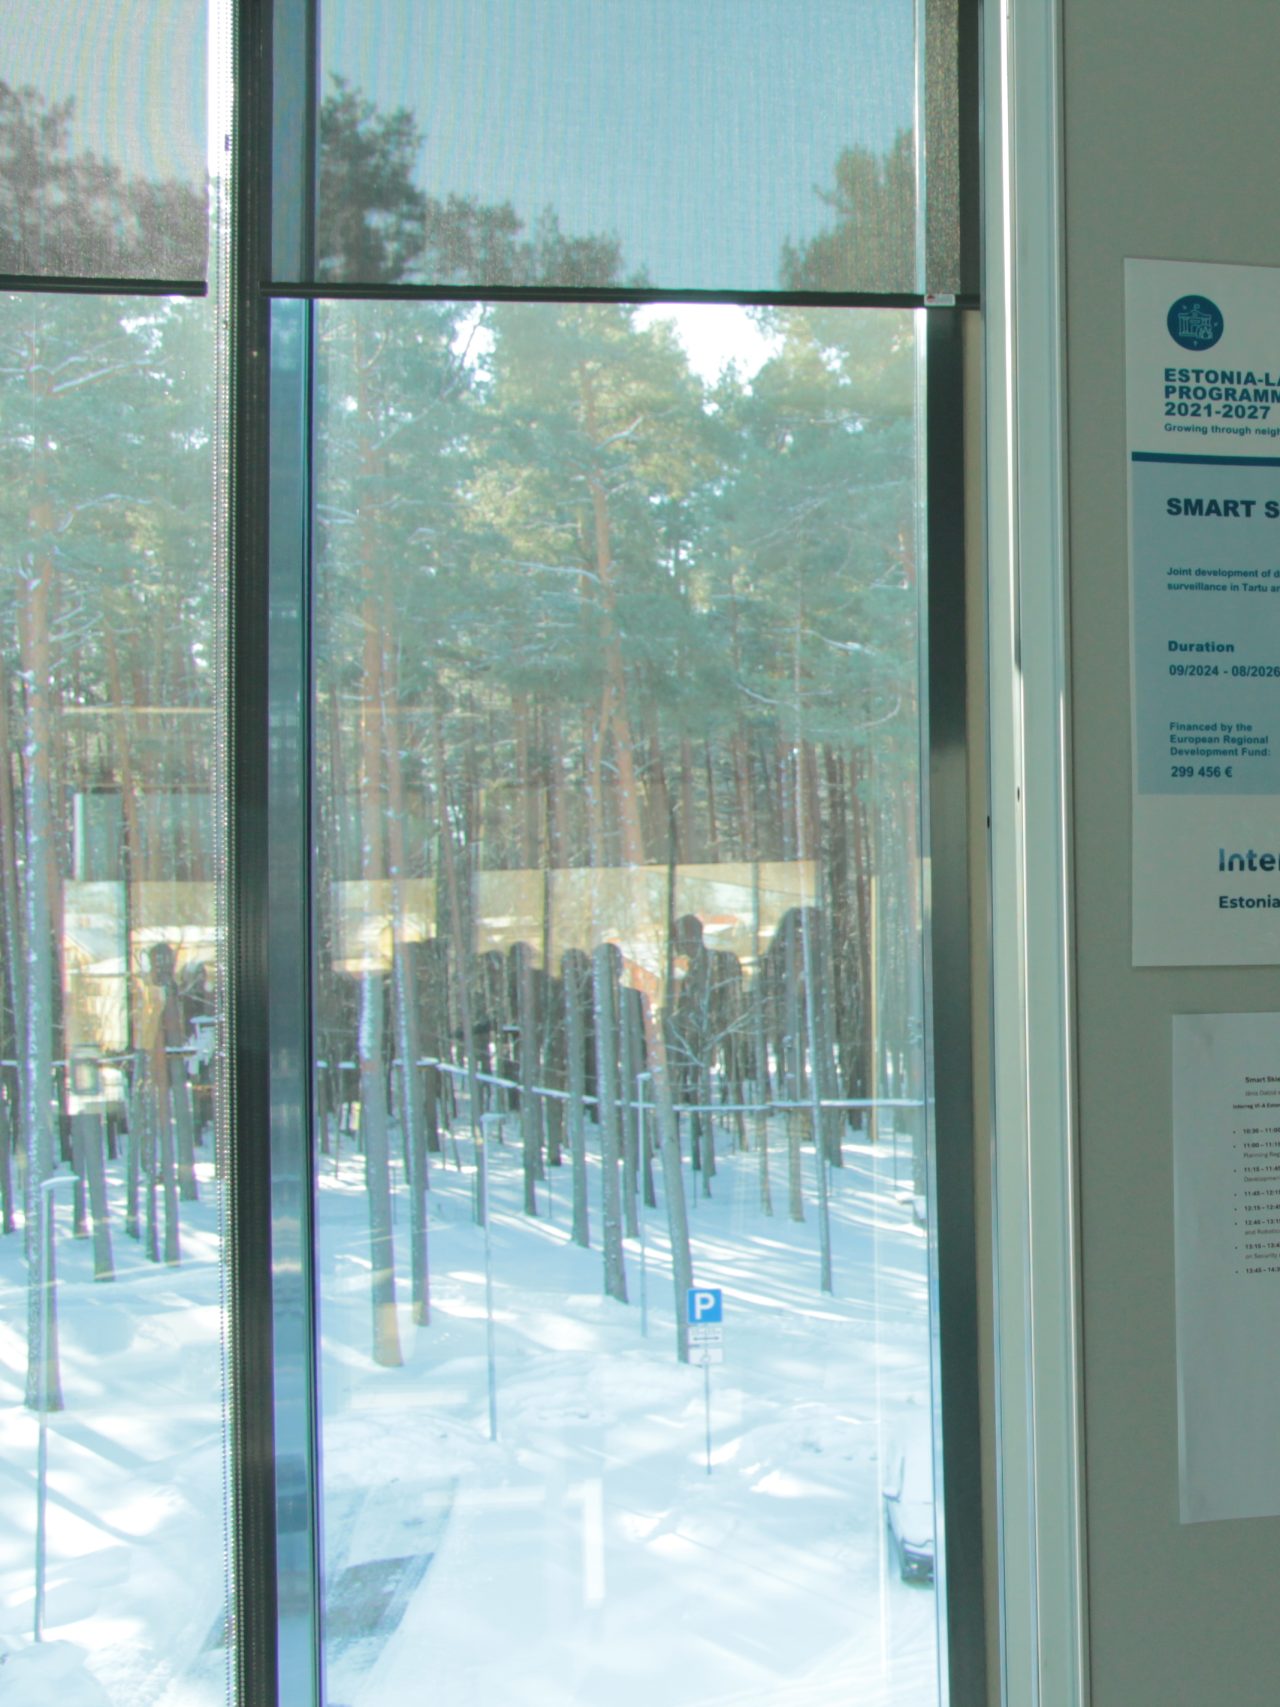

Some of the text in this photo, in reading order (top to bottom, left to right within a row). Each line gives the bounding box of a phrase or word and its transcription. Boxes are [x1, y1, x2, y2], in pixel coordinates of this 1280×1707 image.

[1164, 402, 1271, 420] 2021-2027
[1164, 423, 1208, 435] Growing
[1211, 425, 1251, 437] through
[1167, 498, 1256, 517] SMART
[1167, 567, 1192, 577] Joint
[1195, 568, 1258, 580] development
[1261, 569, 1271, 578] of
[1167, 582, 1227, 592] surveillance
[1230, 583, 1239, 592] in
[1242, 583, 1267, 593] Tartu
[1168, 640, 1235, 653] Duration
[1169, 664, 1219, 676] 09/2024
[1231, 665, 1280, 677] 08/2026
[1170, 722, 1252, 734] Financed by the
[1170, 735, 1269, 746] European Regional
[1170, 747, 1271, 758] Development Fund:
[1171, 766, 1233, 778] 299 456 €
[1219, 894, 1280, 909] Estonia
[694, 1293, 715, 1320] P
